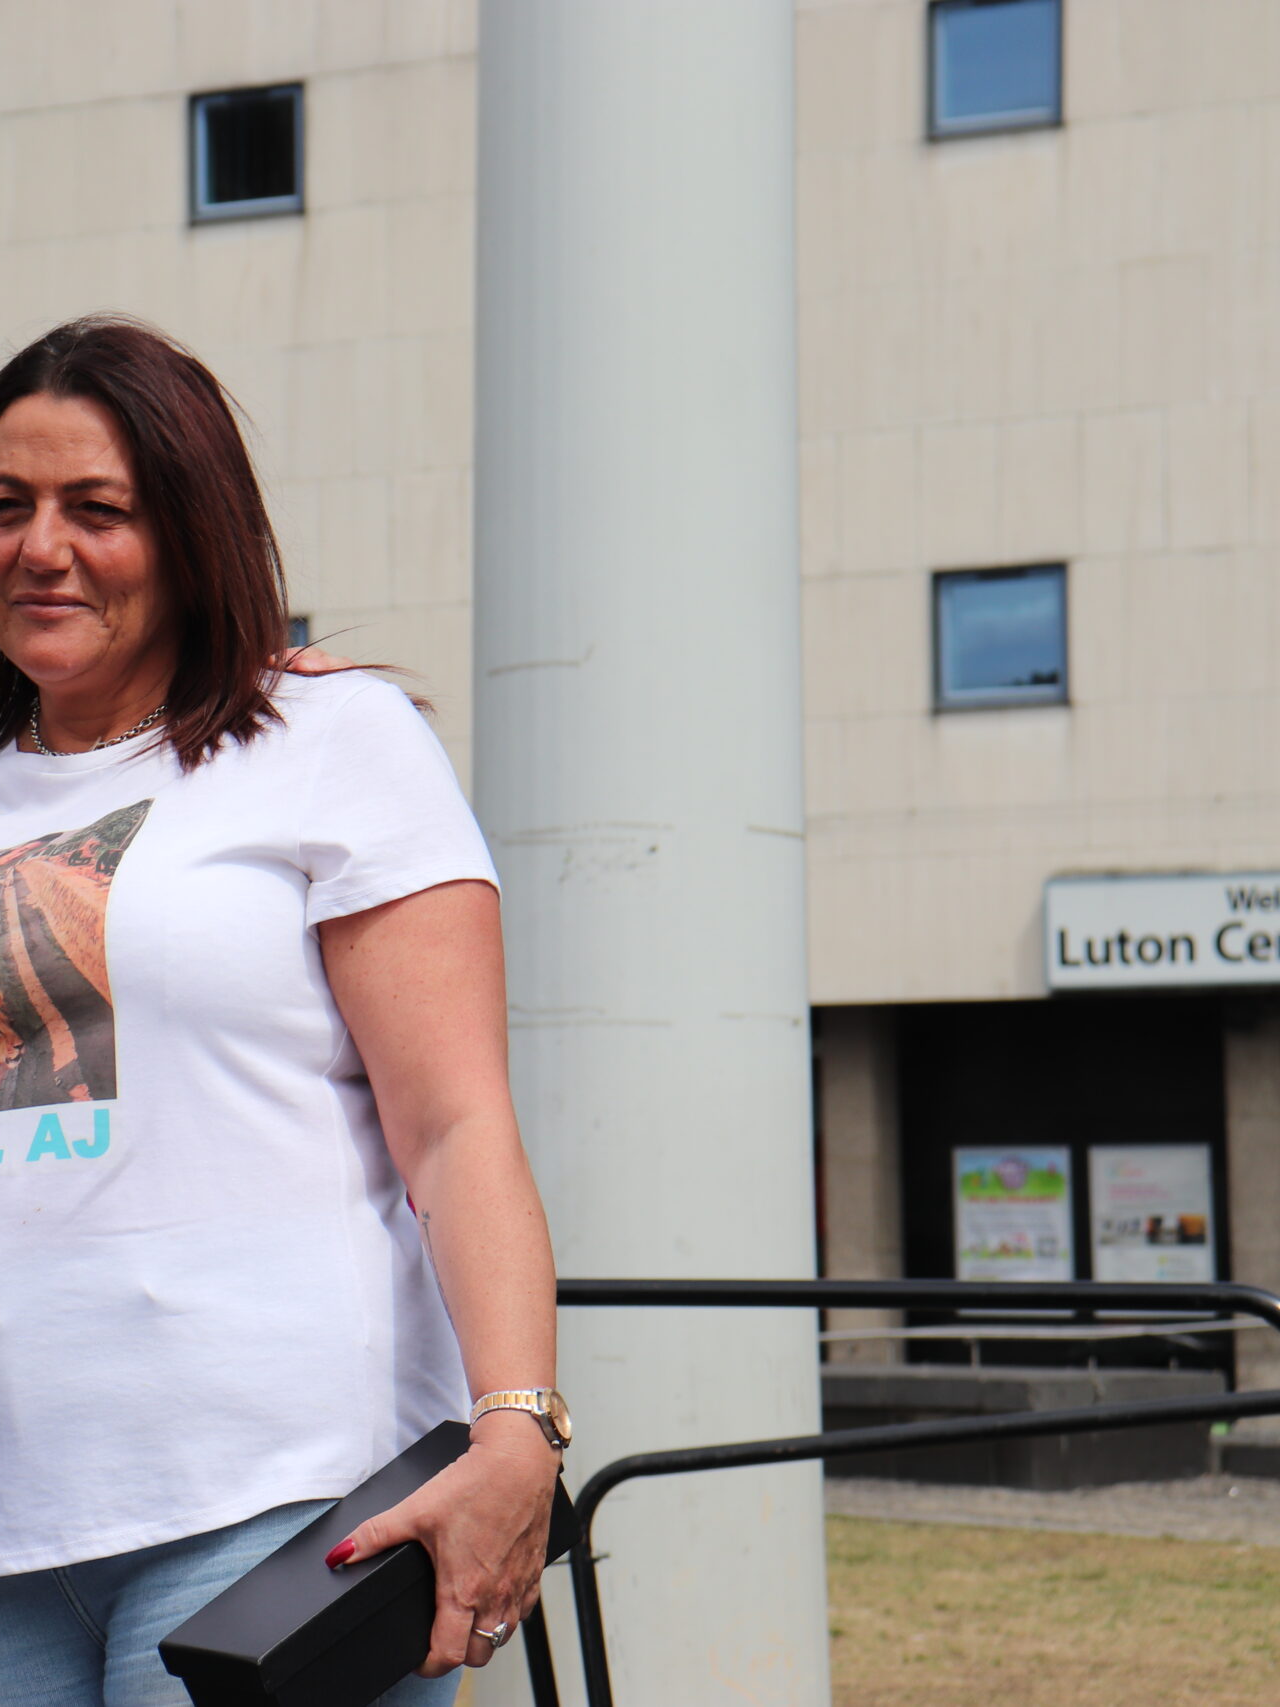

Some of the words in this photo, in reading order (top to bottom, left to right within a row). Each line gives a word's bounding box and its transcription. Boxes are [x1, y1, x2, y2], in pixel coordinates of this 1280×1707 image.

[1058, 928, 1197, 967] Luton
[1215, 921, 1280, 962] Ce
[26, 1108, 110, 1162] AJ
